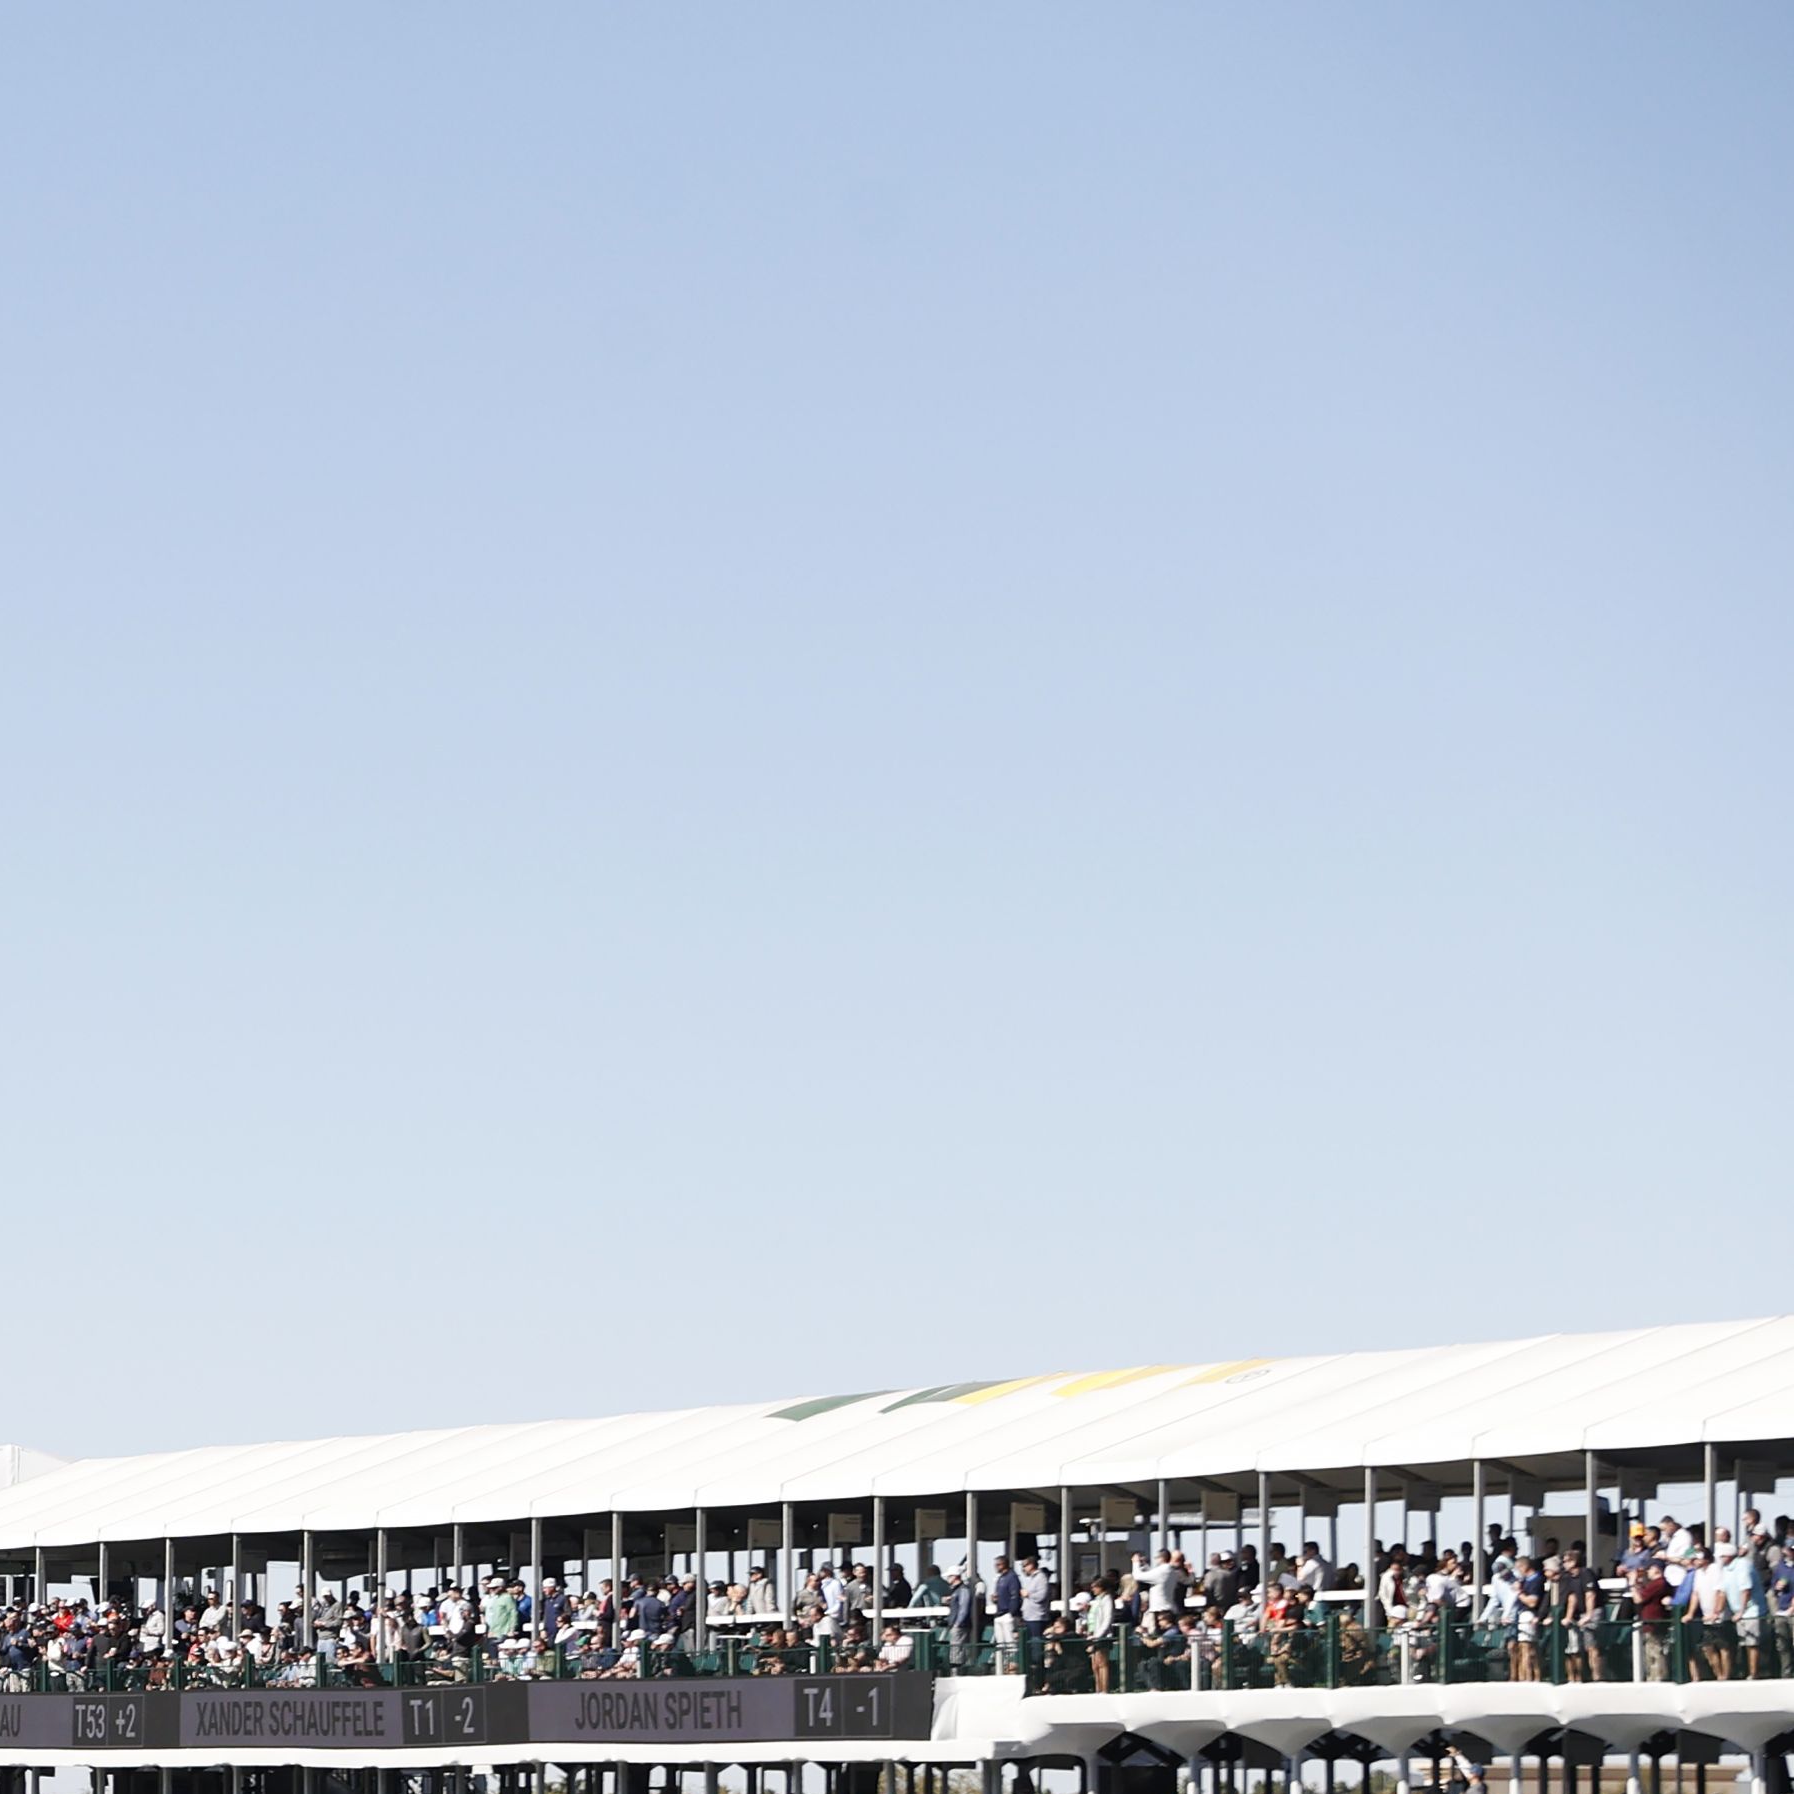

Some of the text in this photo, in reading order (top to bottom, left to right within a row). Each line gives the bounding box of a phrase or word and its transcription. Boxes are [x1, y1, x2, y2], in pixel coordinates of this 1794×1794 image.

[75, 1704, 136, 1738] T53 +2
[196, 1700, 385, 1737] XANDER SCHAUFFELE
[410, 1696, 475, 1736] T1 -2
[575, 1690, 742, 1730] JORDAN SPIETH
[803, 1687, 879, 1727] T4 -1
